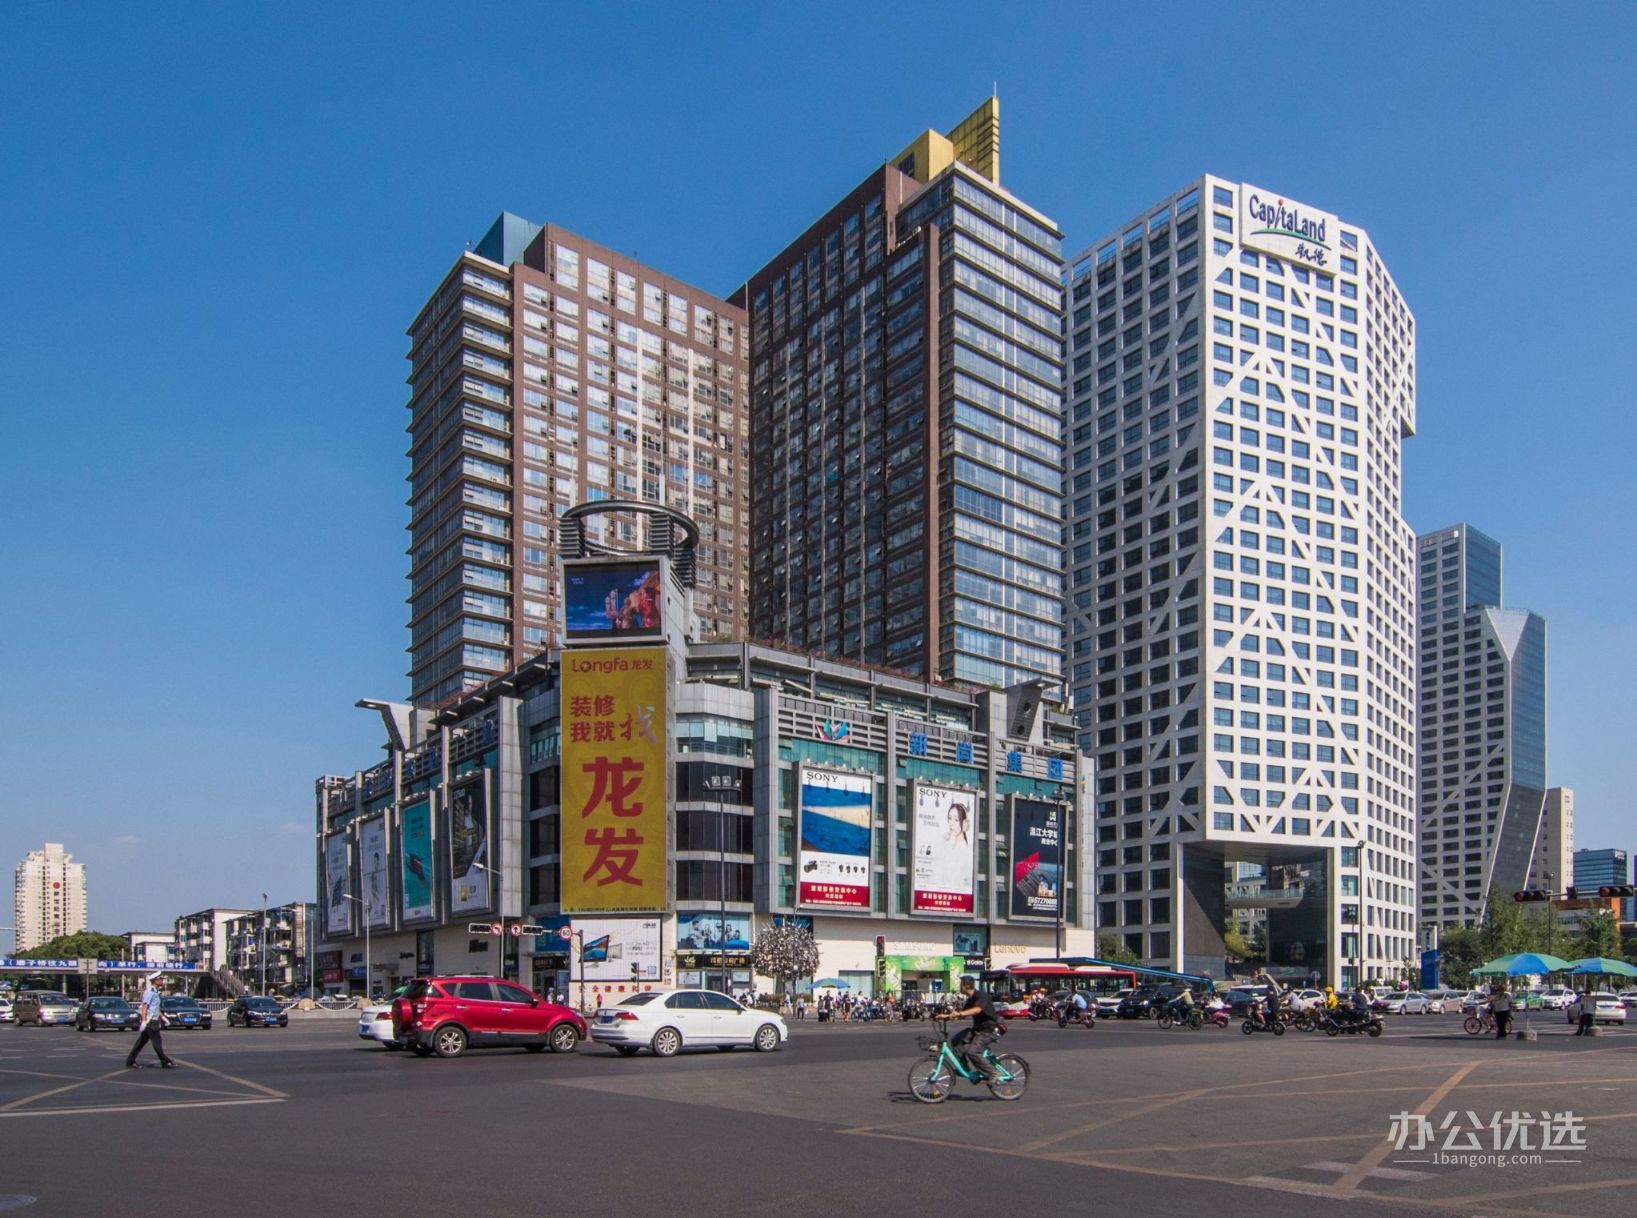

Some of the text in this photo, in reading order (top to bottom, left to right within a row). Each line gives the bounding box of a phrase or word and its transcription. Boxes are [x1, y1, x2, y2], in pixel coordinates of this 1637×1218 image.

[1249, 194, 1326, 242] CapitaLand
[571, 657, 654, 673] Longfa 龙发
[570, 695, 616, 717] 装修
[806, 771, 839, 783] SONY
[919, 787, 948, 798] SONY
[581, 756, 645, 887] 龙发
